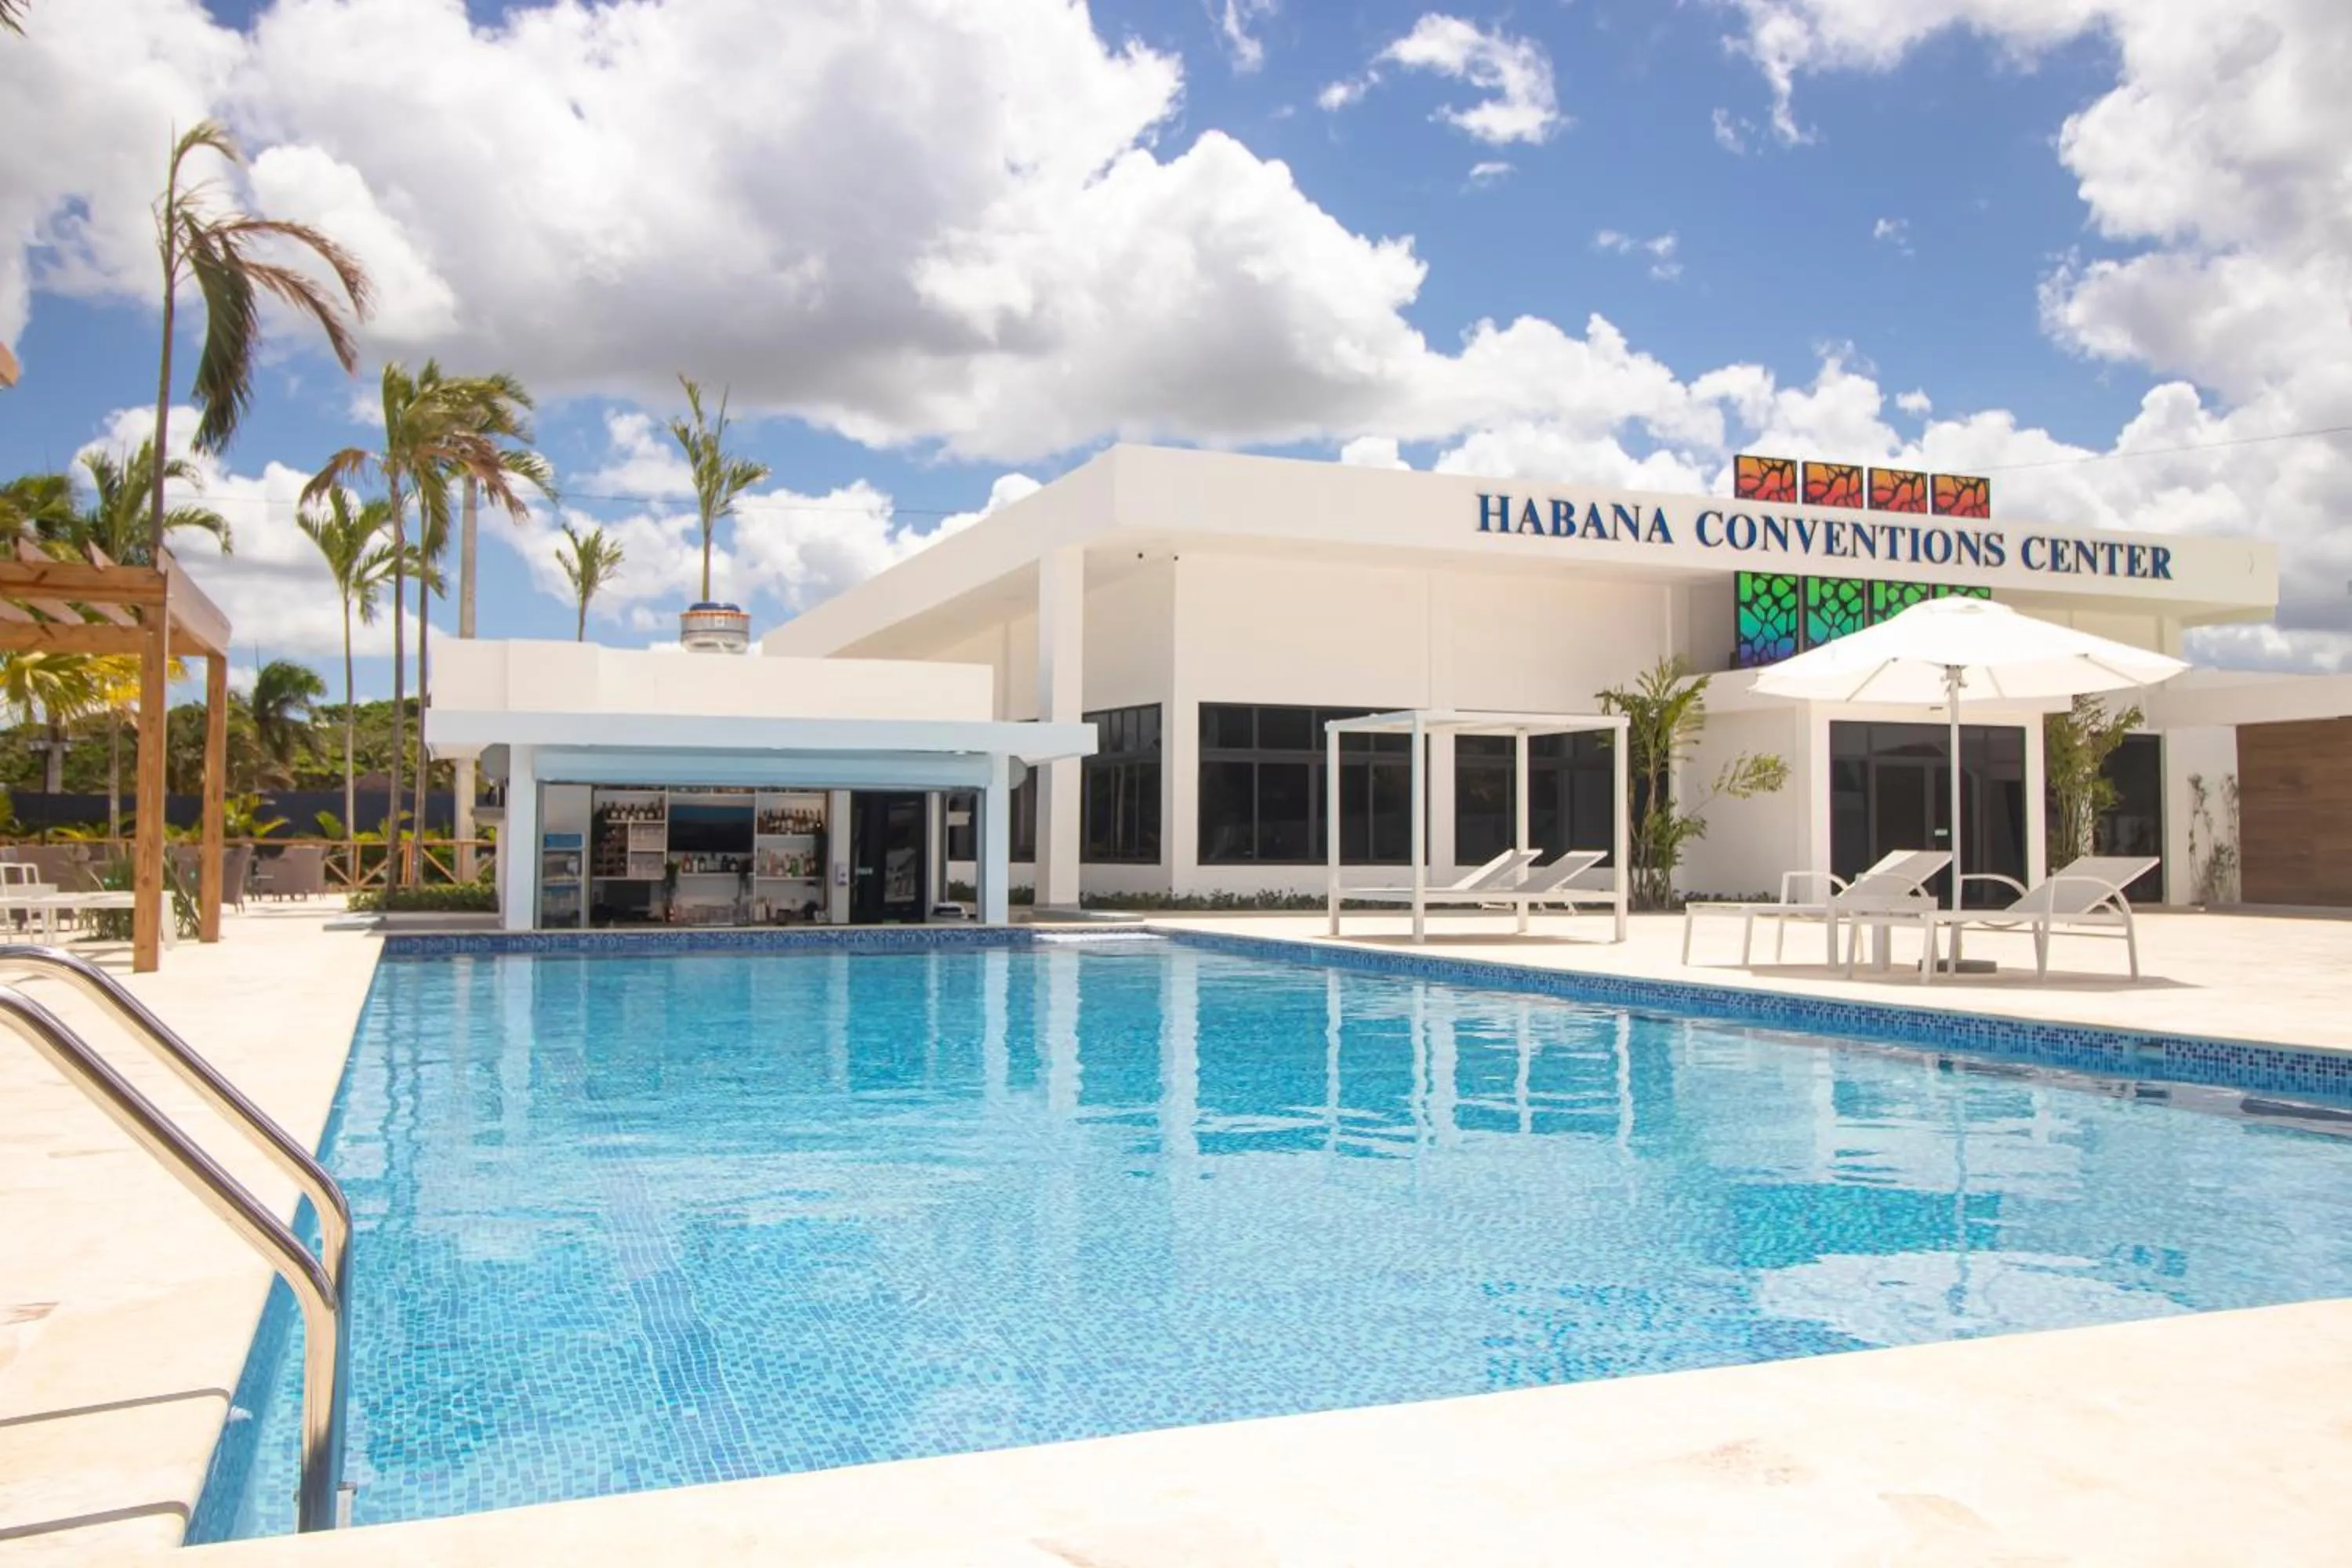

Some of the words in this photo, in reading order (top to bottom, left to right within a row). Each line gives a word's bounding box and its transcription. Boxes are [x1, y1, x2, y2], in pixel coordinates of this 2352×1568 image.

[1475, 492, 1674, 544] HABANA
[1694, 510, 2006, 568] CONVENTIONS
[2020, 535, 2174, 581] CENTER
